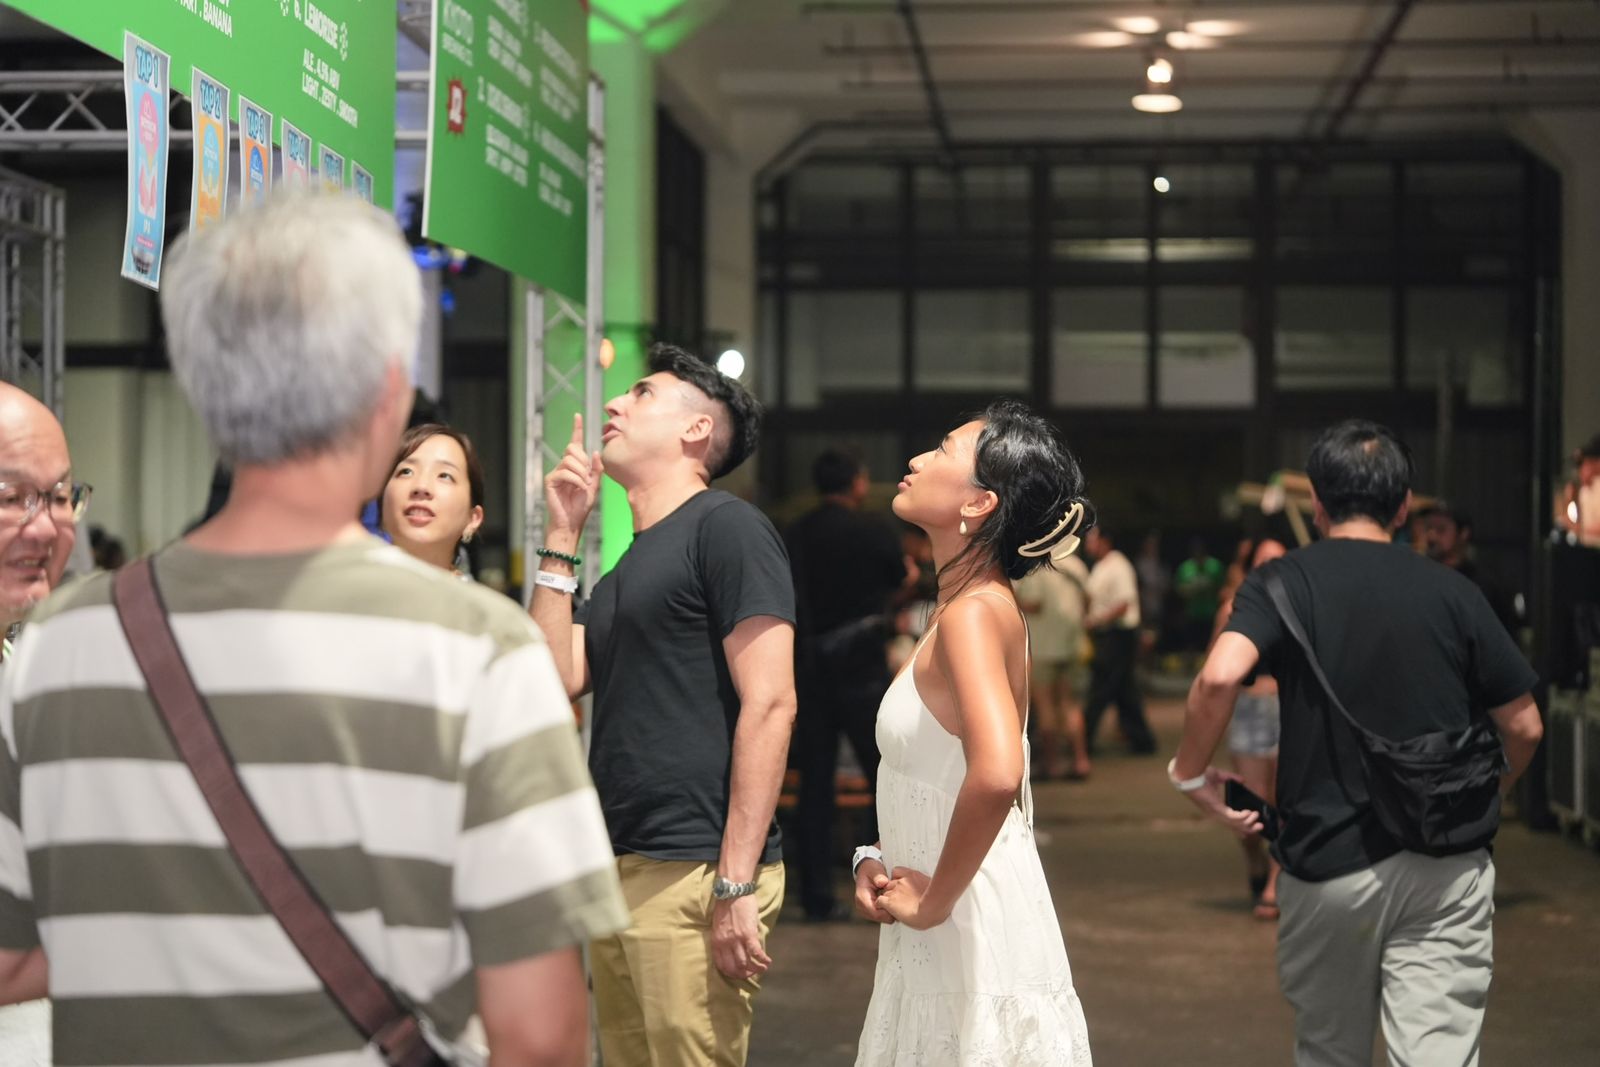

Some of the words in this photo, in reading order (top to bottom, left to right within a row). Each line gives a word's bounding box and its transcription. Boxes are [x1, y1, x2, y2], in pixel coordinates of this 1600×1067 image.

[203, 0, 233, 38] BANANA
[135, 45, 153, 84] TAP
[153, 54, 160, 88] 1
[303, 48, 315, 73] ALE
[200, 79, 214, 115] TAP
[214, 87, 221, 120] 2
[302, 72, 319, 101] LIGHT
[246, 106, 260, 140] TAP
